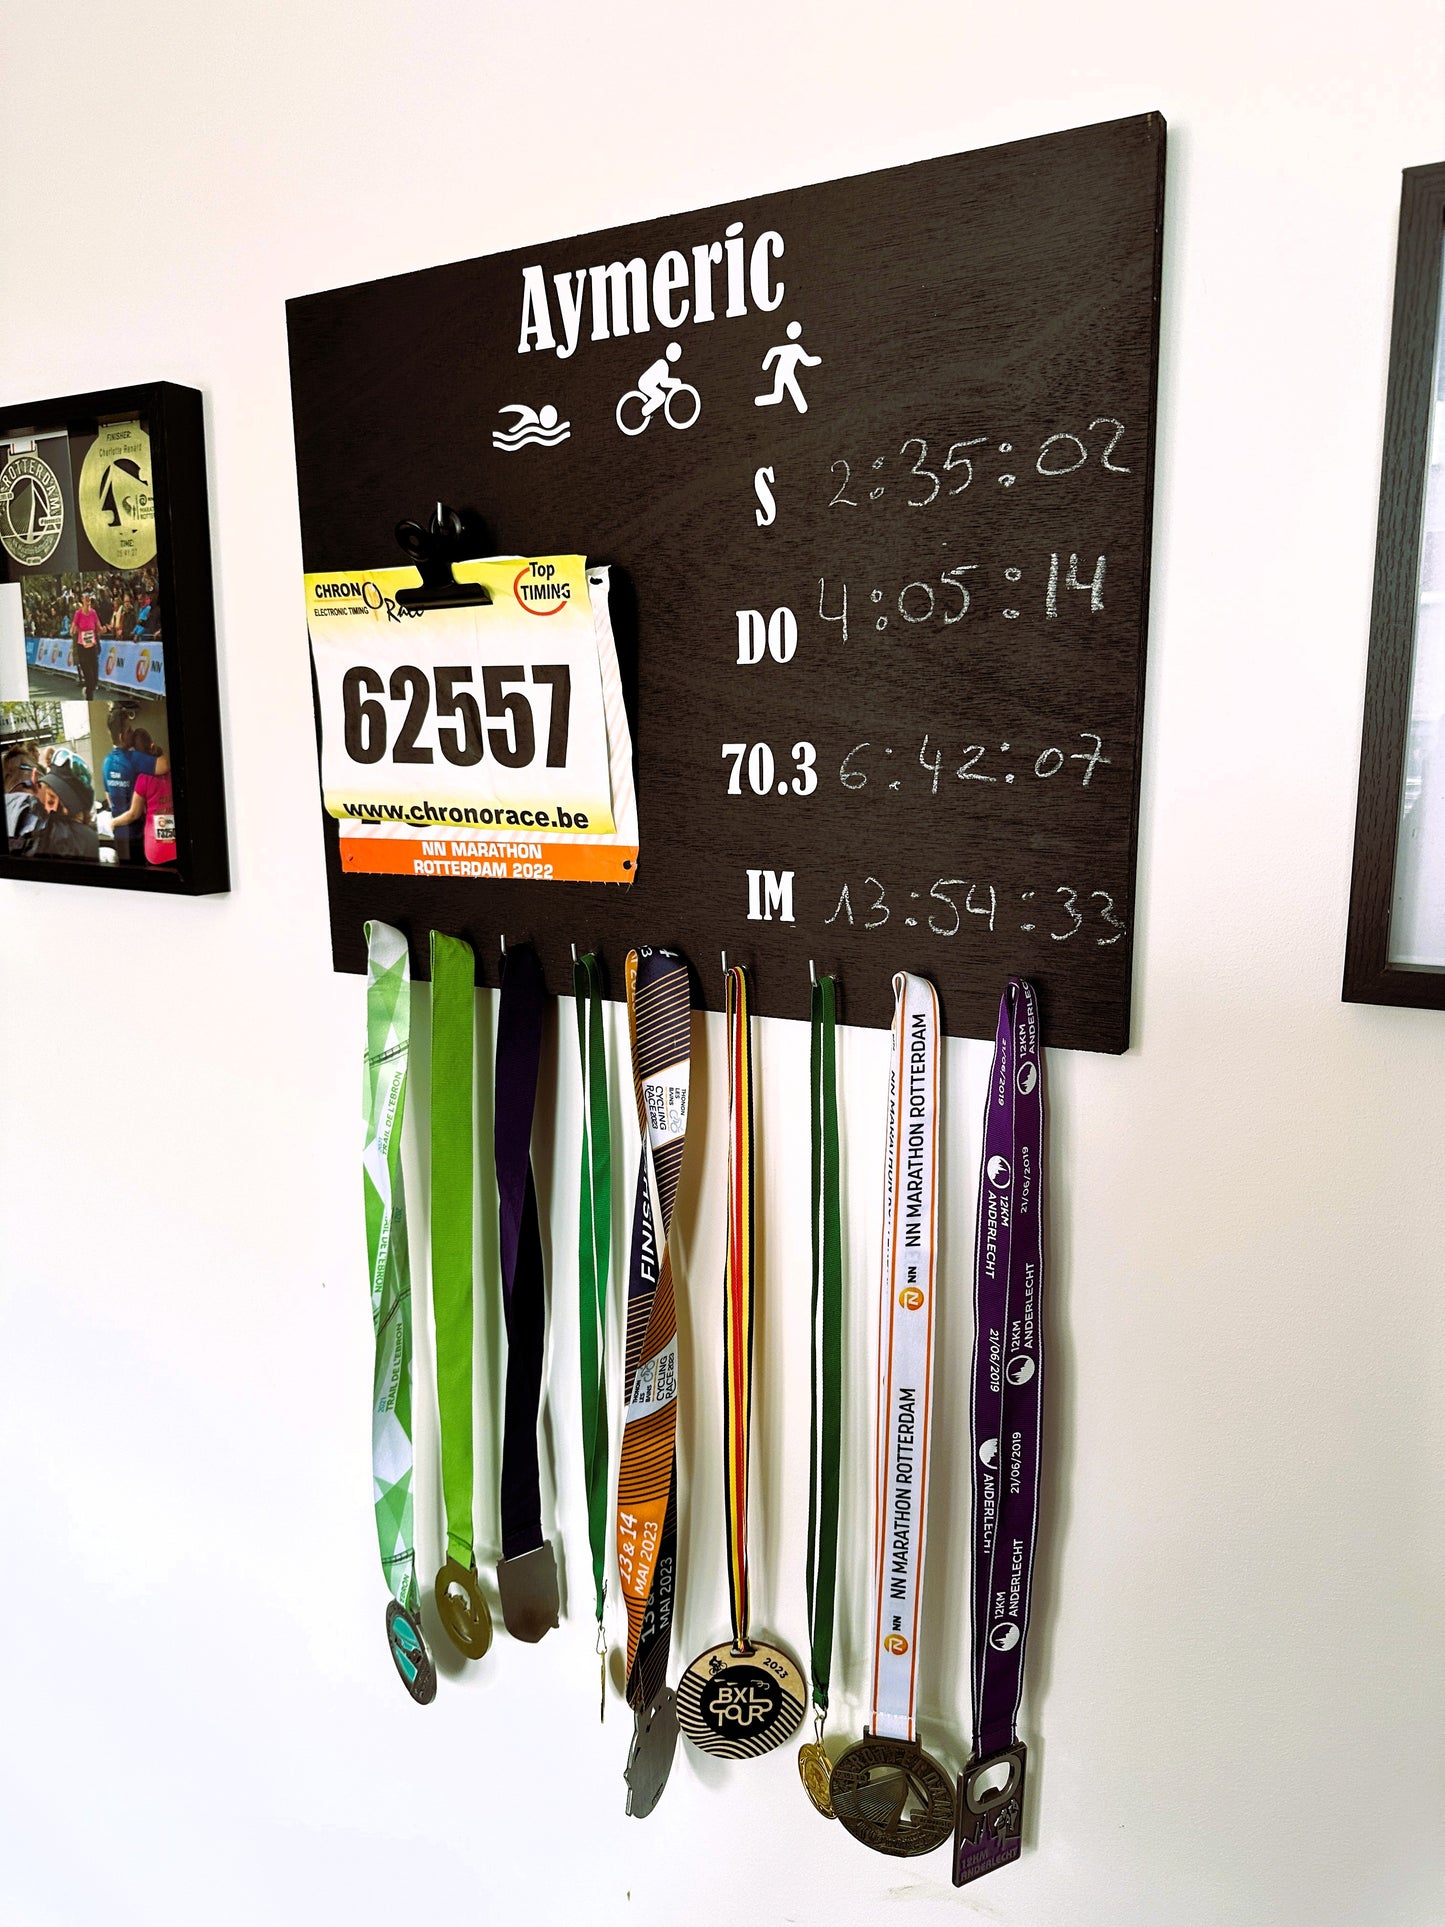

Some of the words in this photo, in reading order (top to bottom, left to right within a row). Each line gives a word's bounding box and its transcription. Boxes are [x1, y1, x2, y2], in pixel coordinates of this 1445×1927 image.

[518, 221, 785, 359] Aymeric
[753, 465, 777, 527] S
[529, 562, 555, 581] Top
[314, 607, 348, 616] ELECTRONIC
[349, 606, 369, 615] TIMING
[520, 583, 571, 600] TIMING
[735, 606, 799, 665] DO
[342, 664, 571, 768] 62557
[721, 740, 818, 796] 70.3
[343, 801, 589, 829] www.chronorace.be
[413, 859, 507, 877] ROTTERDAM
[513, 863, 553, 879] 2022
[422, 841, 446, 856] NN
[451, 842, 542, 859] MARATHON
[745, 868, 796, 922] IM
[1019, 1023, 1027, 1059] 12KM
[910, 1013, 926, 1118] ROTTERDAM
[998, 1038, 1007, 1106] 21/06/2019
[655, 1086, 667, 1130] CYCLING
[382, 1128, 390, 1155] TRAIL
[386, 1114, 394, 1128] DE
[906, 1123, 924, 1217] MARATHON
[1020, 1146, 1031, 1214] 21/06/2019
[1000, 1195, 1009, 1227] 12KM
[905, 1223, 921, 1247] NN
[985, 1190, 997, 1279] ANDERLECHT
[908, 1266, 917, 1283] NN
[1024, 1263, 1034, 1349] ANDERLECHT
[1011, 1320, 1021, 1352] 12KM
[656, 1355, 667, 1401] CYCLING
[989, 1328, 1000, 1392] 21/06/2019
[386, 1382, 398, 1412] TRAIL
[392, 1366, 400, 1381] DE
[896, 1388, 916, 1484] ROTTERDAM
[1010, 1431, 1022, 1494] 21/06/2019
[620, 1511, 637, 1539] 14
[640, 1521, 658, 1561] 2023
[892, 1488, 911, 1574] MARATHON
[619, 1553, 633, 1584] 13
[634, 1563, 650, 1596] MAI
[660, 1557, 672, 1596] 2023
[1009, 1539, 1023, 1617] ANDERLECHT
[890, 1577, 906, 1600] NN
[994, 1591, 1006, 1620] 12KM
[660, 1597, 671, 1629] MAI
[892, 1615, 901, 1631] NN
[763, 1657, 789, 1679] 2023
[718, 1687, 754, 1703] BXL
[711, 1704, 765, 1726] TOUR
